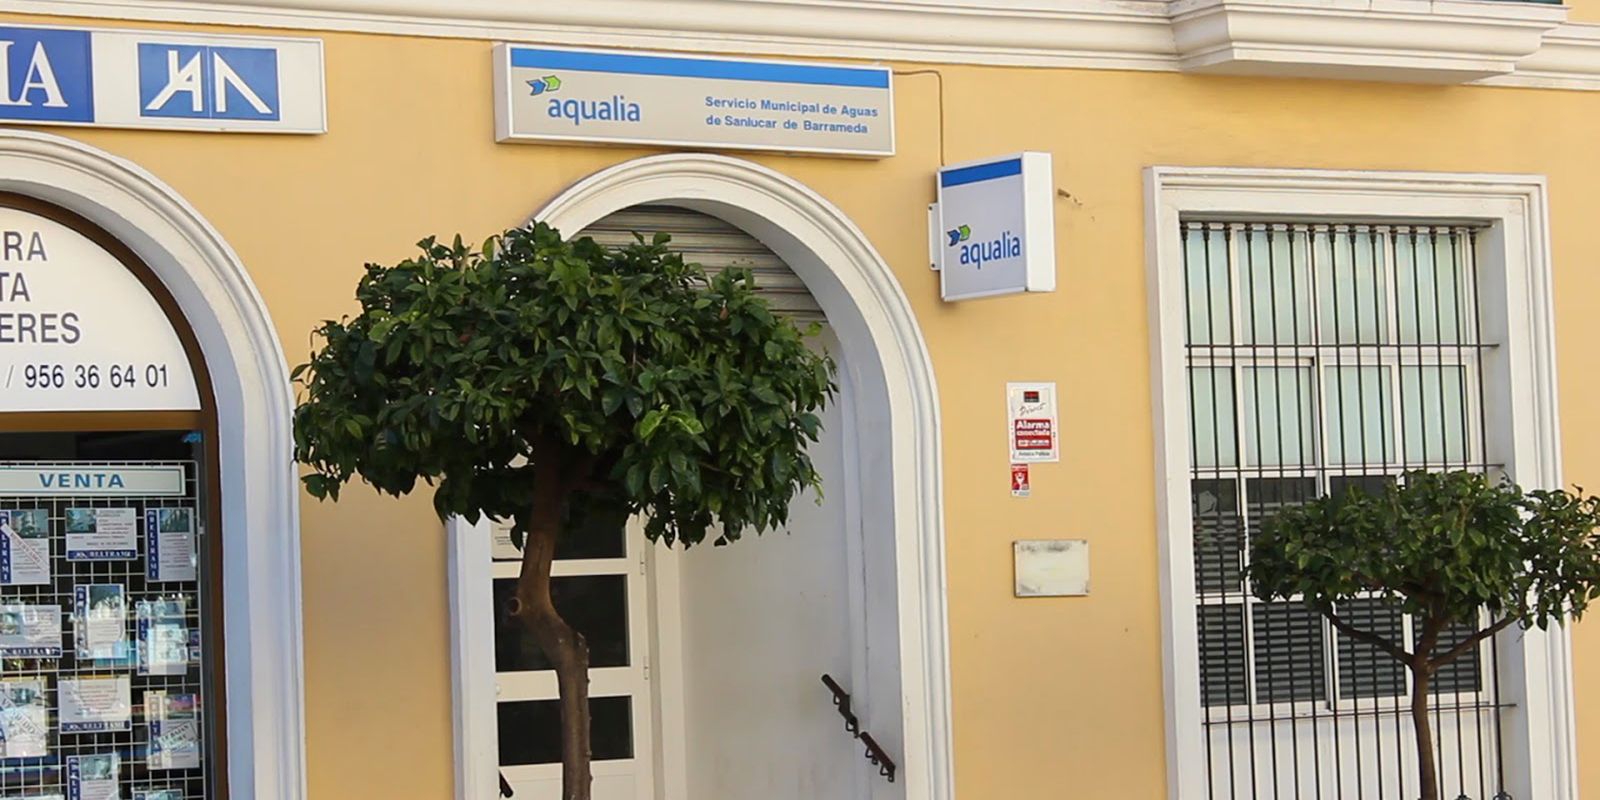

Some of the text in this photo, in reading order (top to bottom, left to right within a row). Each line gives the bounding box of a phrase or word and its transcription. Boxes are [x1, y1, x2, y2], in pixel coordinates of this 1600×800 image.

[547, 95, 641, 126] aqualia
[705, 96, 879, 119] Servicio Municipal de Aguas
[706, 115, 868, 134] de Sanlucar de Barrameda
[3, 231, 47, 262] RA
[960, 230, 1021, 270] aqualia
[0, 312, 81, 344] ERES
[24, 364, 65, 389] 956
[74, 364, 101, 389] 36
[109, 364, 136, 389] 64
[145, 364, 168, 388] 01
[1017, 420, 1051, 430] Alarma
[39, 473, 125, 488] VENTA
